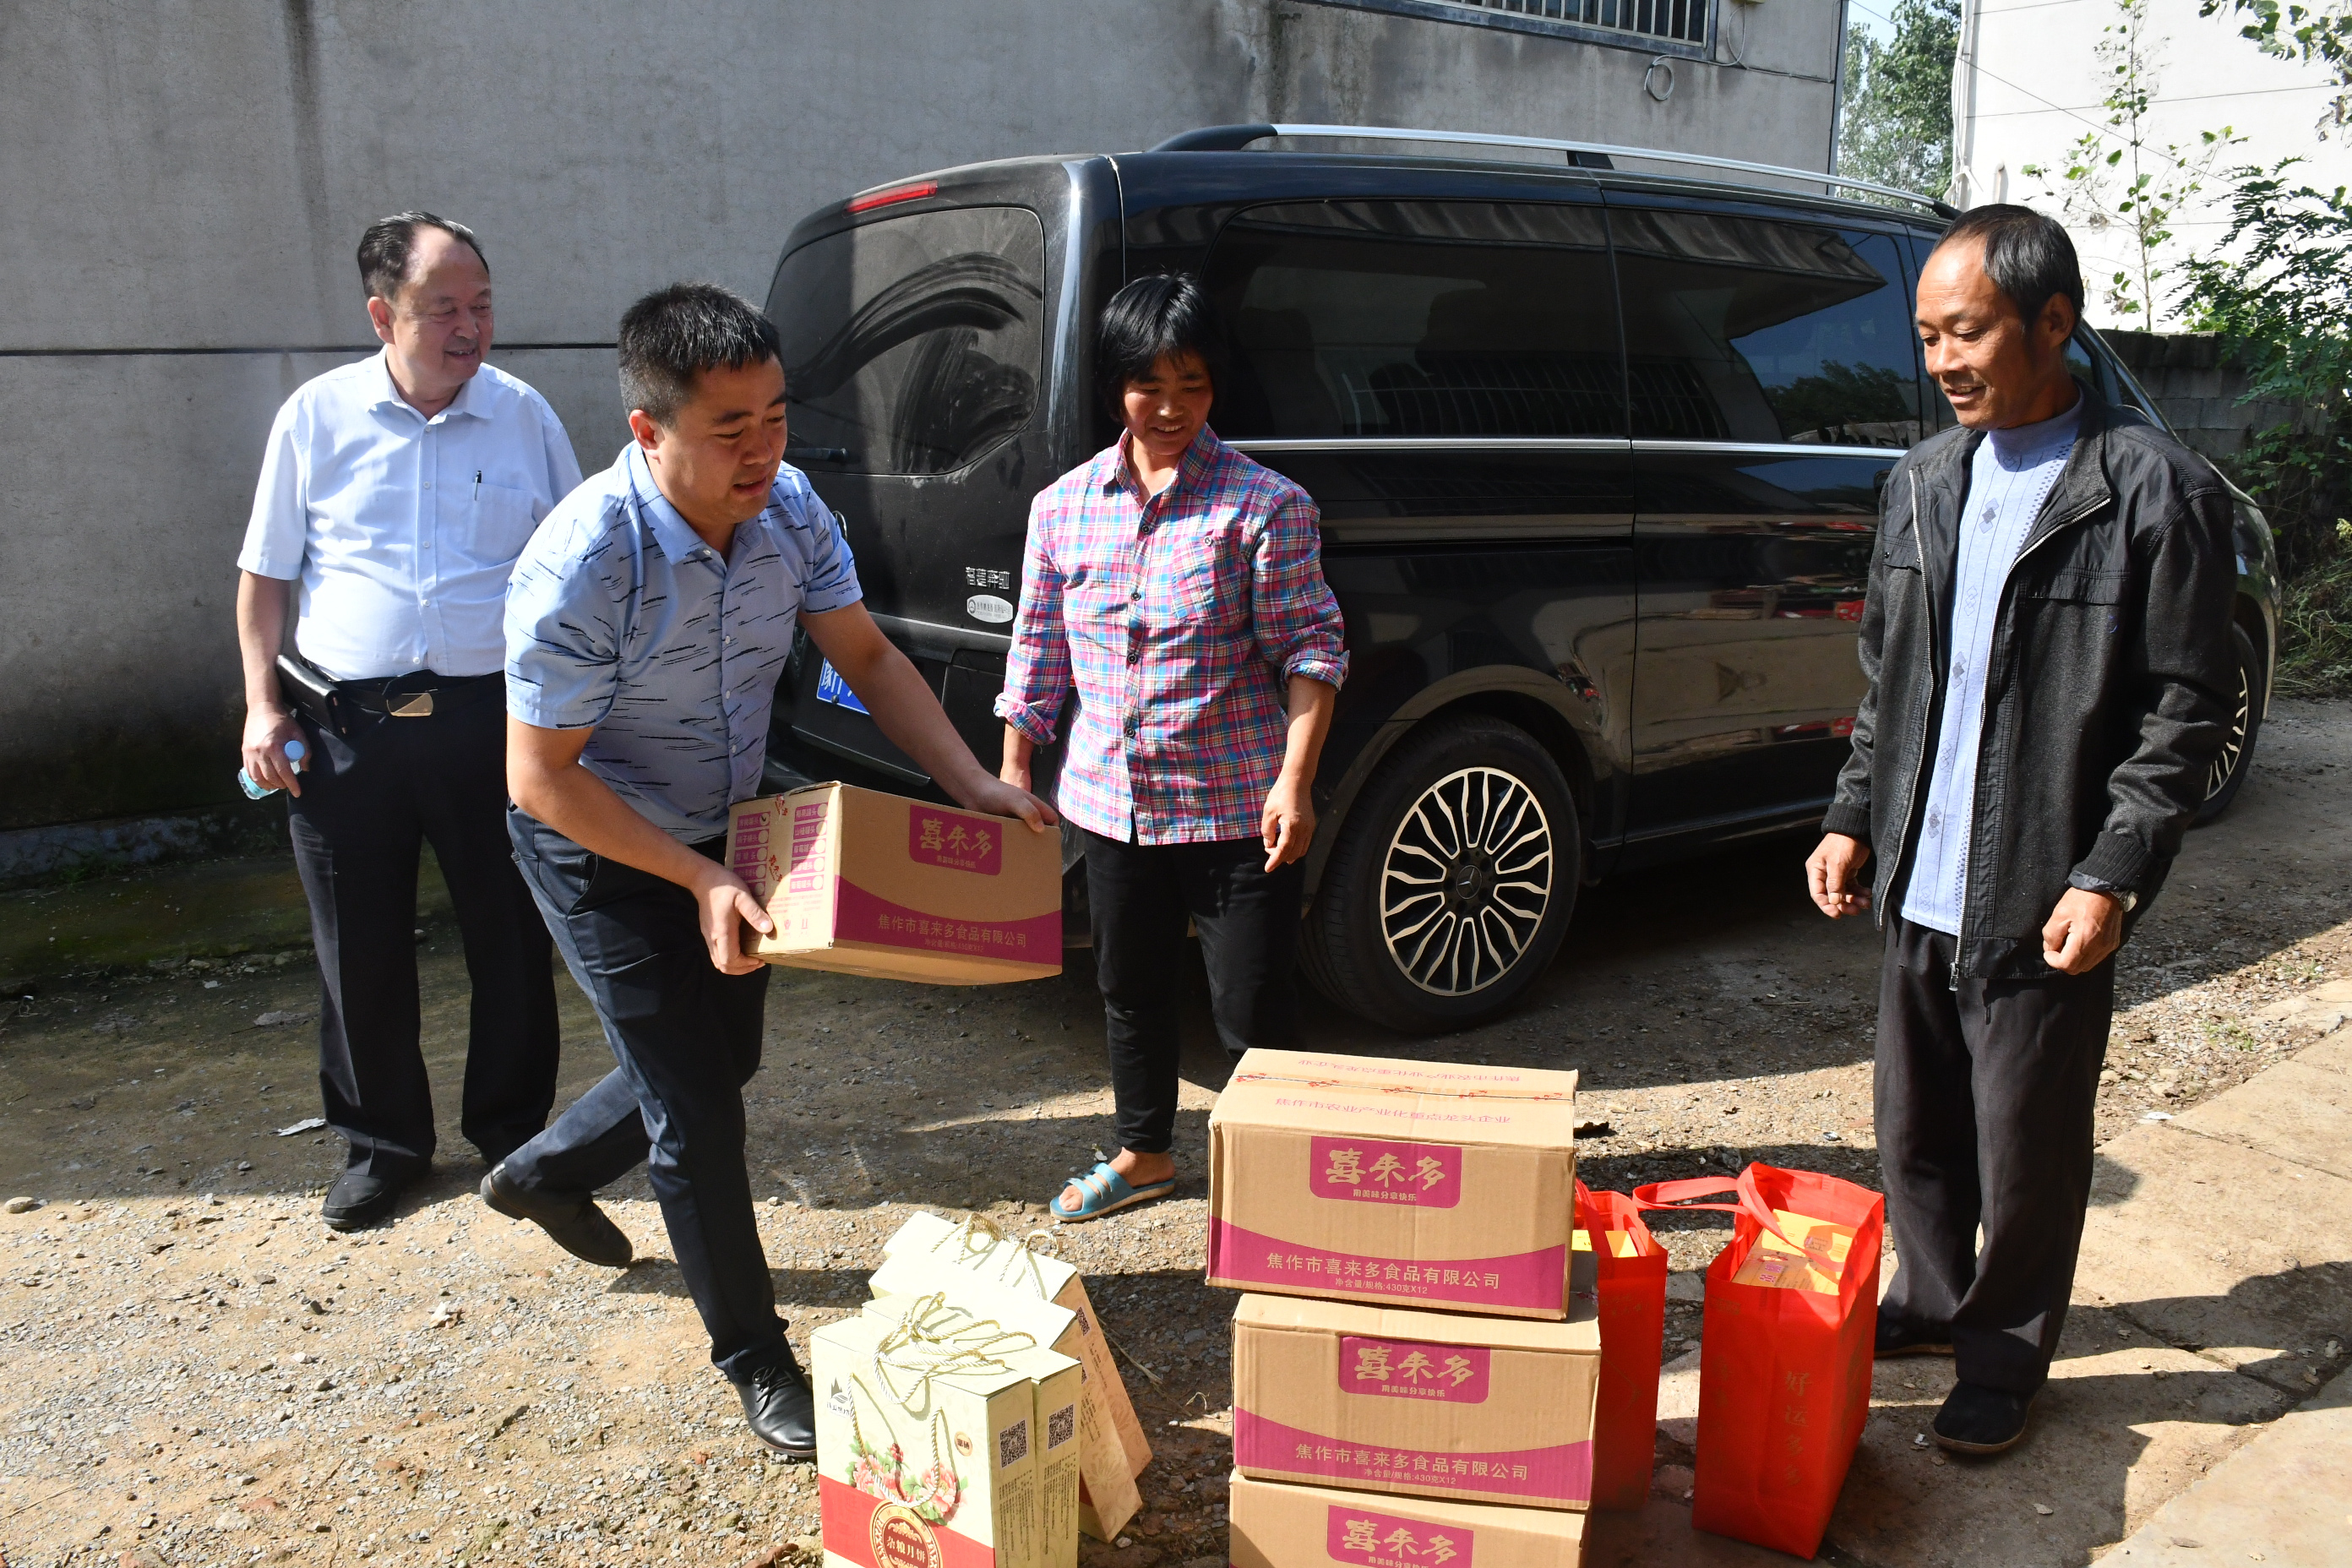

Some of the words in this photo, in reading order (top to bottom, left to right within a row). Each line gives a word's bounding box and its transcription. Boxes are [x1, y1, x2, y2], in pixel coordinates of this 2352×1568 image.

[918, 818, 994, 859] 喜来多
[878, 913, 1026, 948] 焦作市喜来多食品有限公司
[1275, 1098, 1511, 1123] 焦作市农业产业化重点龙头企业
[1326, 1147, 1446, 1190] 喜来多
[1353, 1189, 1417, 1201] 用美味分享快乐
[1266, 1252, 1500, 1289] 焦作市喜来多食品有限公司
[1354, 1345, 1474, 1387] 喜来多
[1381, 1385, 1446, 1396] 用美味分享快乐
[1783, 1369, 1814, 1487] 好运多多
[1295, 1443, 1528, 1481] 焦作市喜来多食品有限公司
[886, 1536, 926, 1563] 杂粮月饼
[1342, 1519, 1457, 1565] 喜来多
